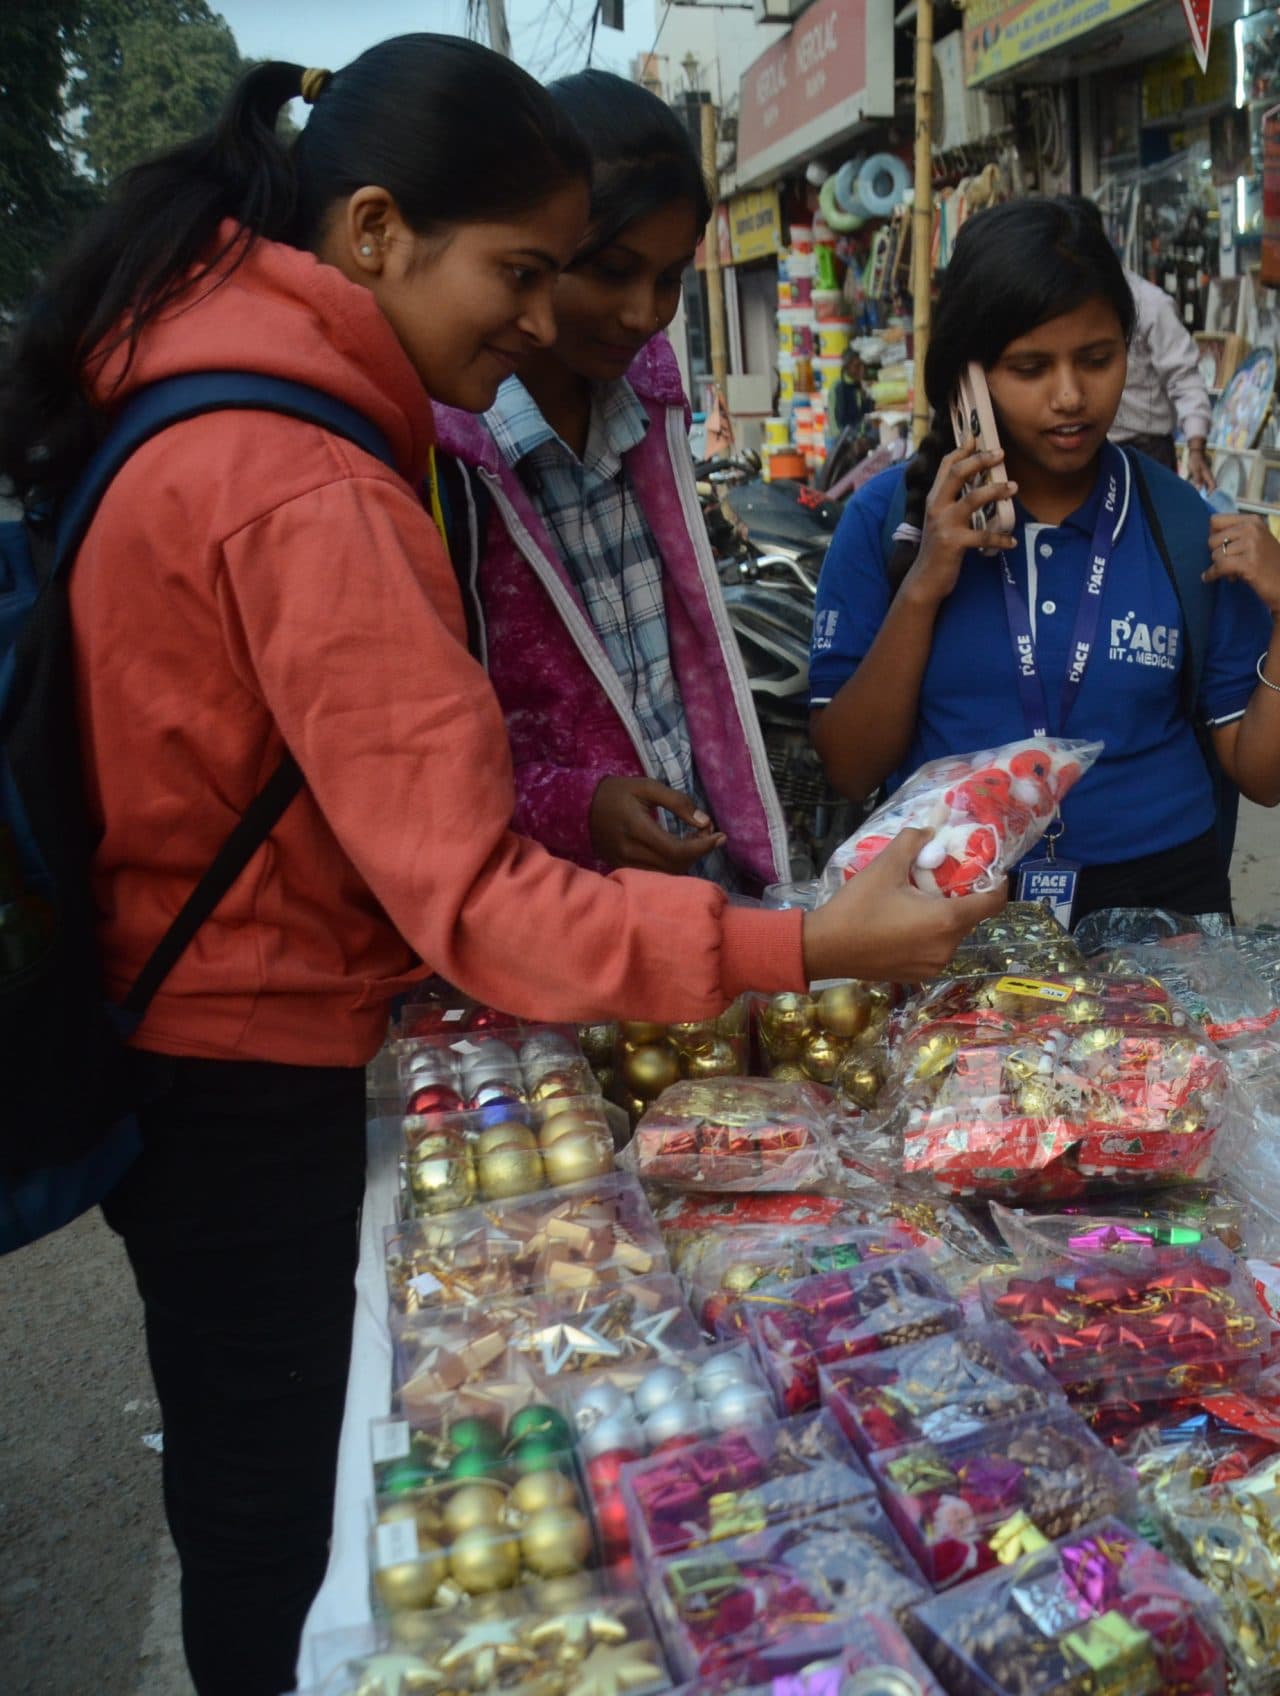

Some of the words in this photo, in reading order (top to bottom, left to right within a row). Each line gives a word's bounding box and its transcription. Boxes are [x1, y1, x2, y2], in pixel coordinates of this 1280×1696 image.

[1088, 556, 1106, 594] PACE
[1110, 611, 1179, 656] PACE
[1017, 635, 1035, 676] PACE
[1069, 642, 1089, 682] PACE
[1109, 647, 1127, 660] IIT
[1135, 650, 1175, 670] MEDICAL
[1031, 873, 1068, 887] PACE
